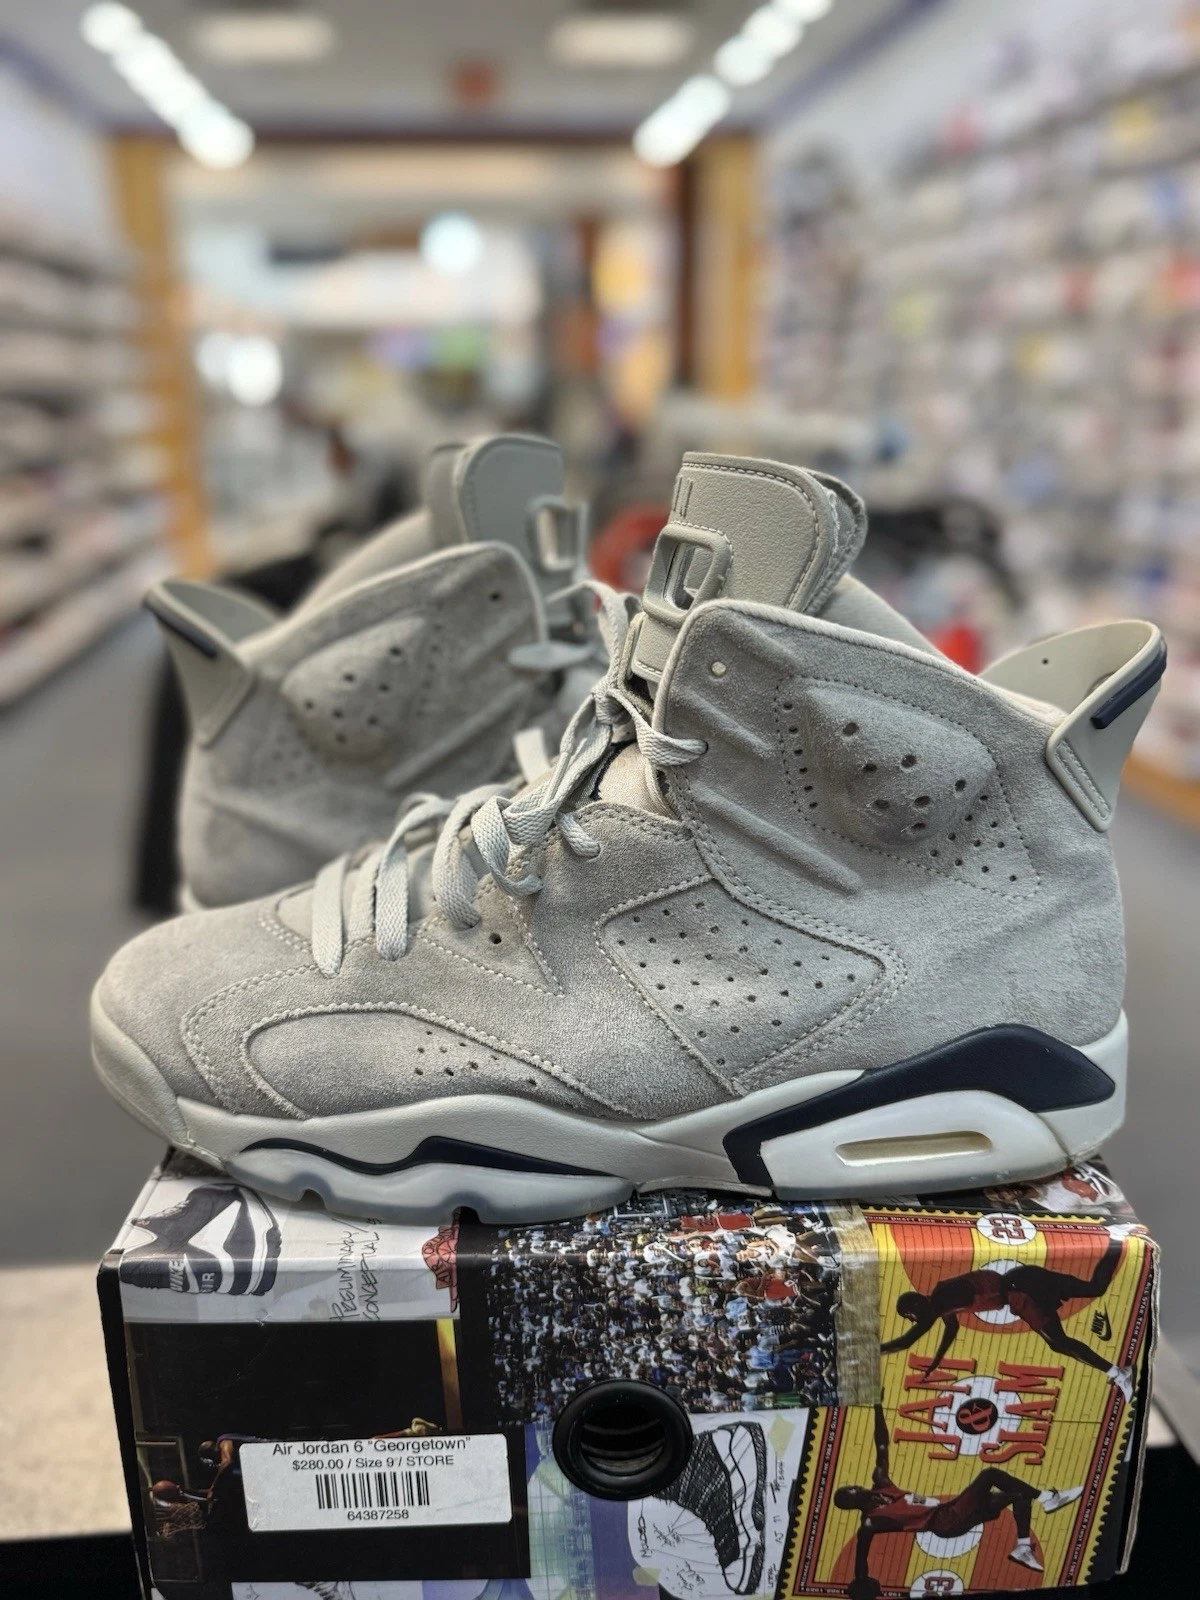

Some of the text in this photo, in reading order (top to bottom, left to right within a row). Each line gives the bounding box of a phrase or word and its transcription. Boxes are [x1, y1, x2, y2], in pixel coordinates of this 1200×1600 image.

[988, 1216, 1026, 1240] 23
[1090, 1309, 1106, 1336] NIKE
[893, 1353, 976, 1460] JAM
[958, 1402, 994, 1432] &
[978, 1360, 1065, 1466] SLAM
[273, 1437, 470, 1456] Air Jordan 6 "Georgetown"
[292, 1458, 344, 1471] $280.00
[356, 1458, 382, 1468] Size
[406, 1454, 454, 1466] STORE
[347, 1510, 410, 1521] 64387258
